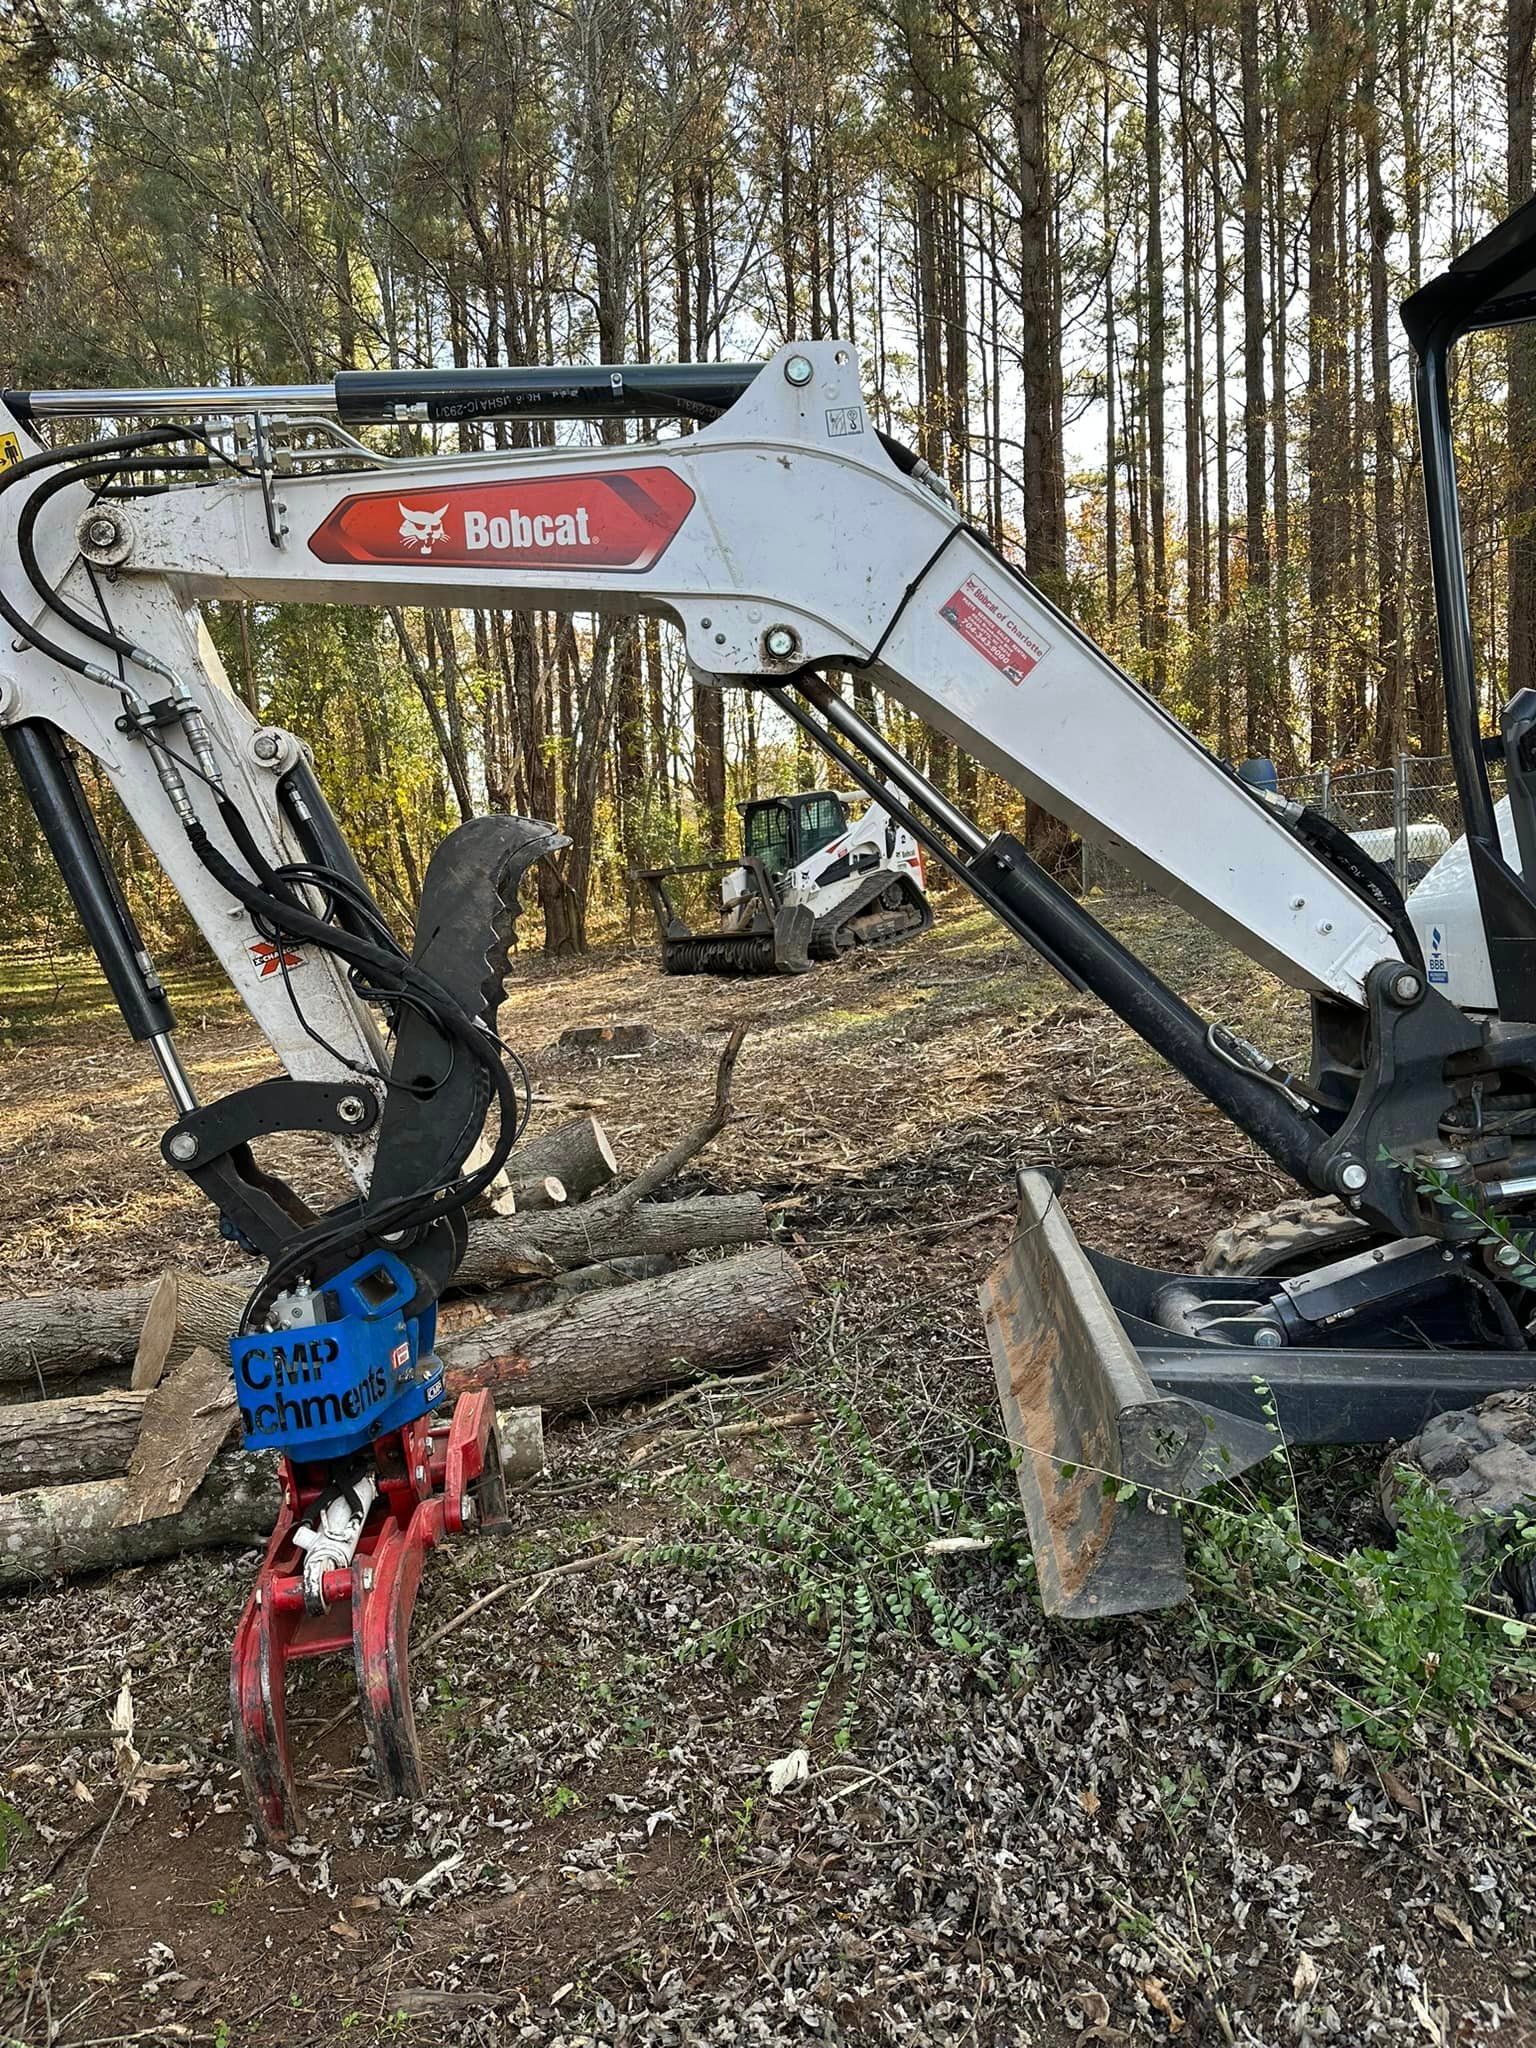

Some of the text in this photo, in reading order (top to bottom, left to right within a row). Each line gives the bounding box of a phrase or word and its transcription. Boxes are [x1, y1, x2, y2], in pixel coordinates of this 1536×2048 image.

[464, 507, 591, 550] Bobcat
[960, 618, 1010, 664] 704-343-9000
[974, 588, 998, 612] Bobcat
[997, 611, 1007, 622] of
[1006, 621, 1043, 657] Charlotte
[1429, 959, 1445, 970] BBB
[240, 1338, 340, 1390] CMP
